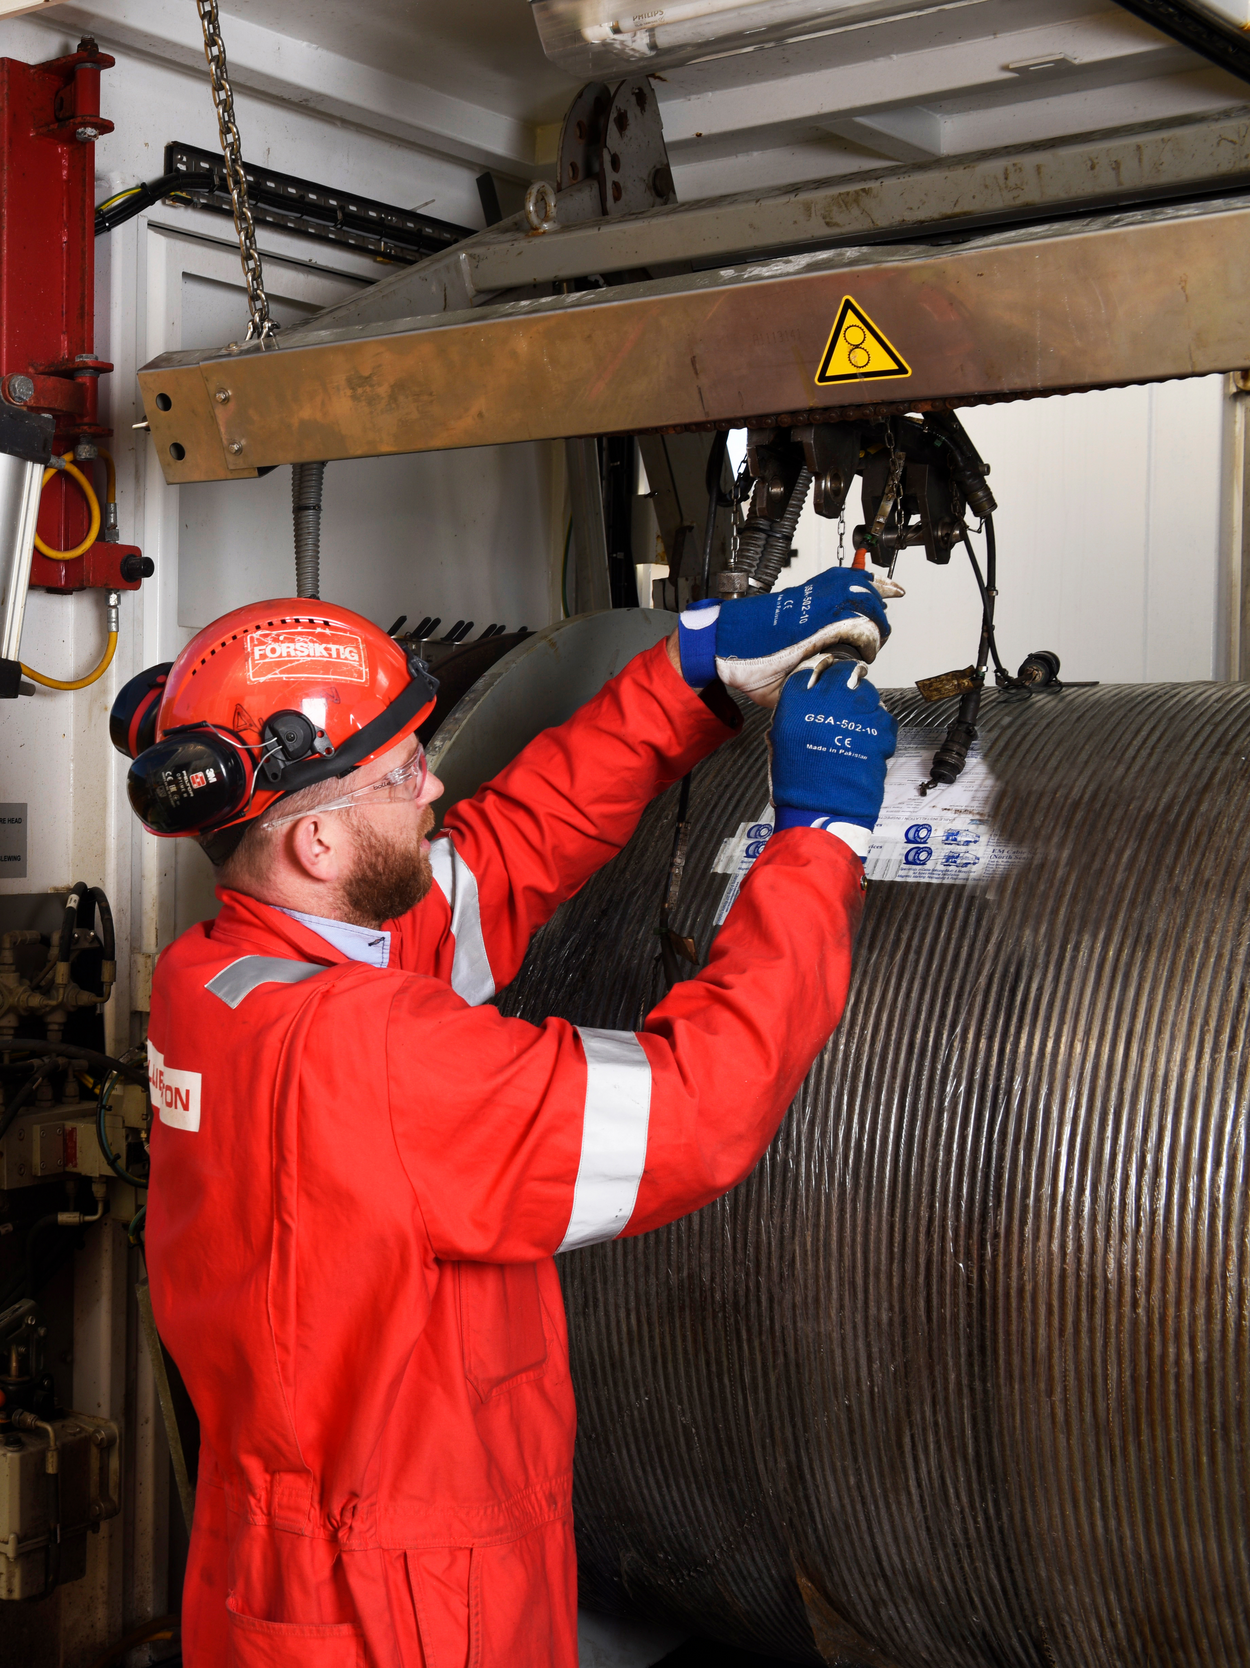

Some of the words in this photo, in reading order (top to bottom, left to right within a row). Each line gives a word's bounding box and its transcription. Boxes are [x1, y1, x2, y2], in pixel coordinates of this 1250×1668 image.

[632, 9, 664, 21] PHILIPS
[253, 642, 359, 661] FORSIKTIG
[804, 713, 878, 736] GSA-502-10
[834, 735, 852, 748] CE
[806, 743, 827, 752] Made
[838, 749, 868, 760] Pakistan
[205, 768, 217, 783] 3M
